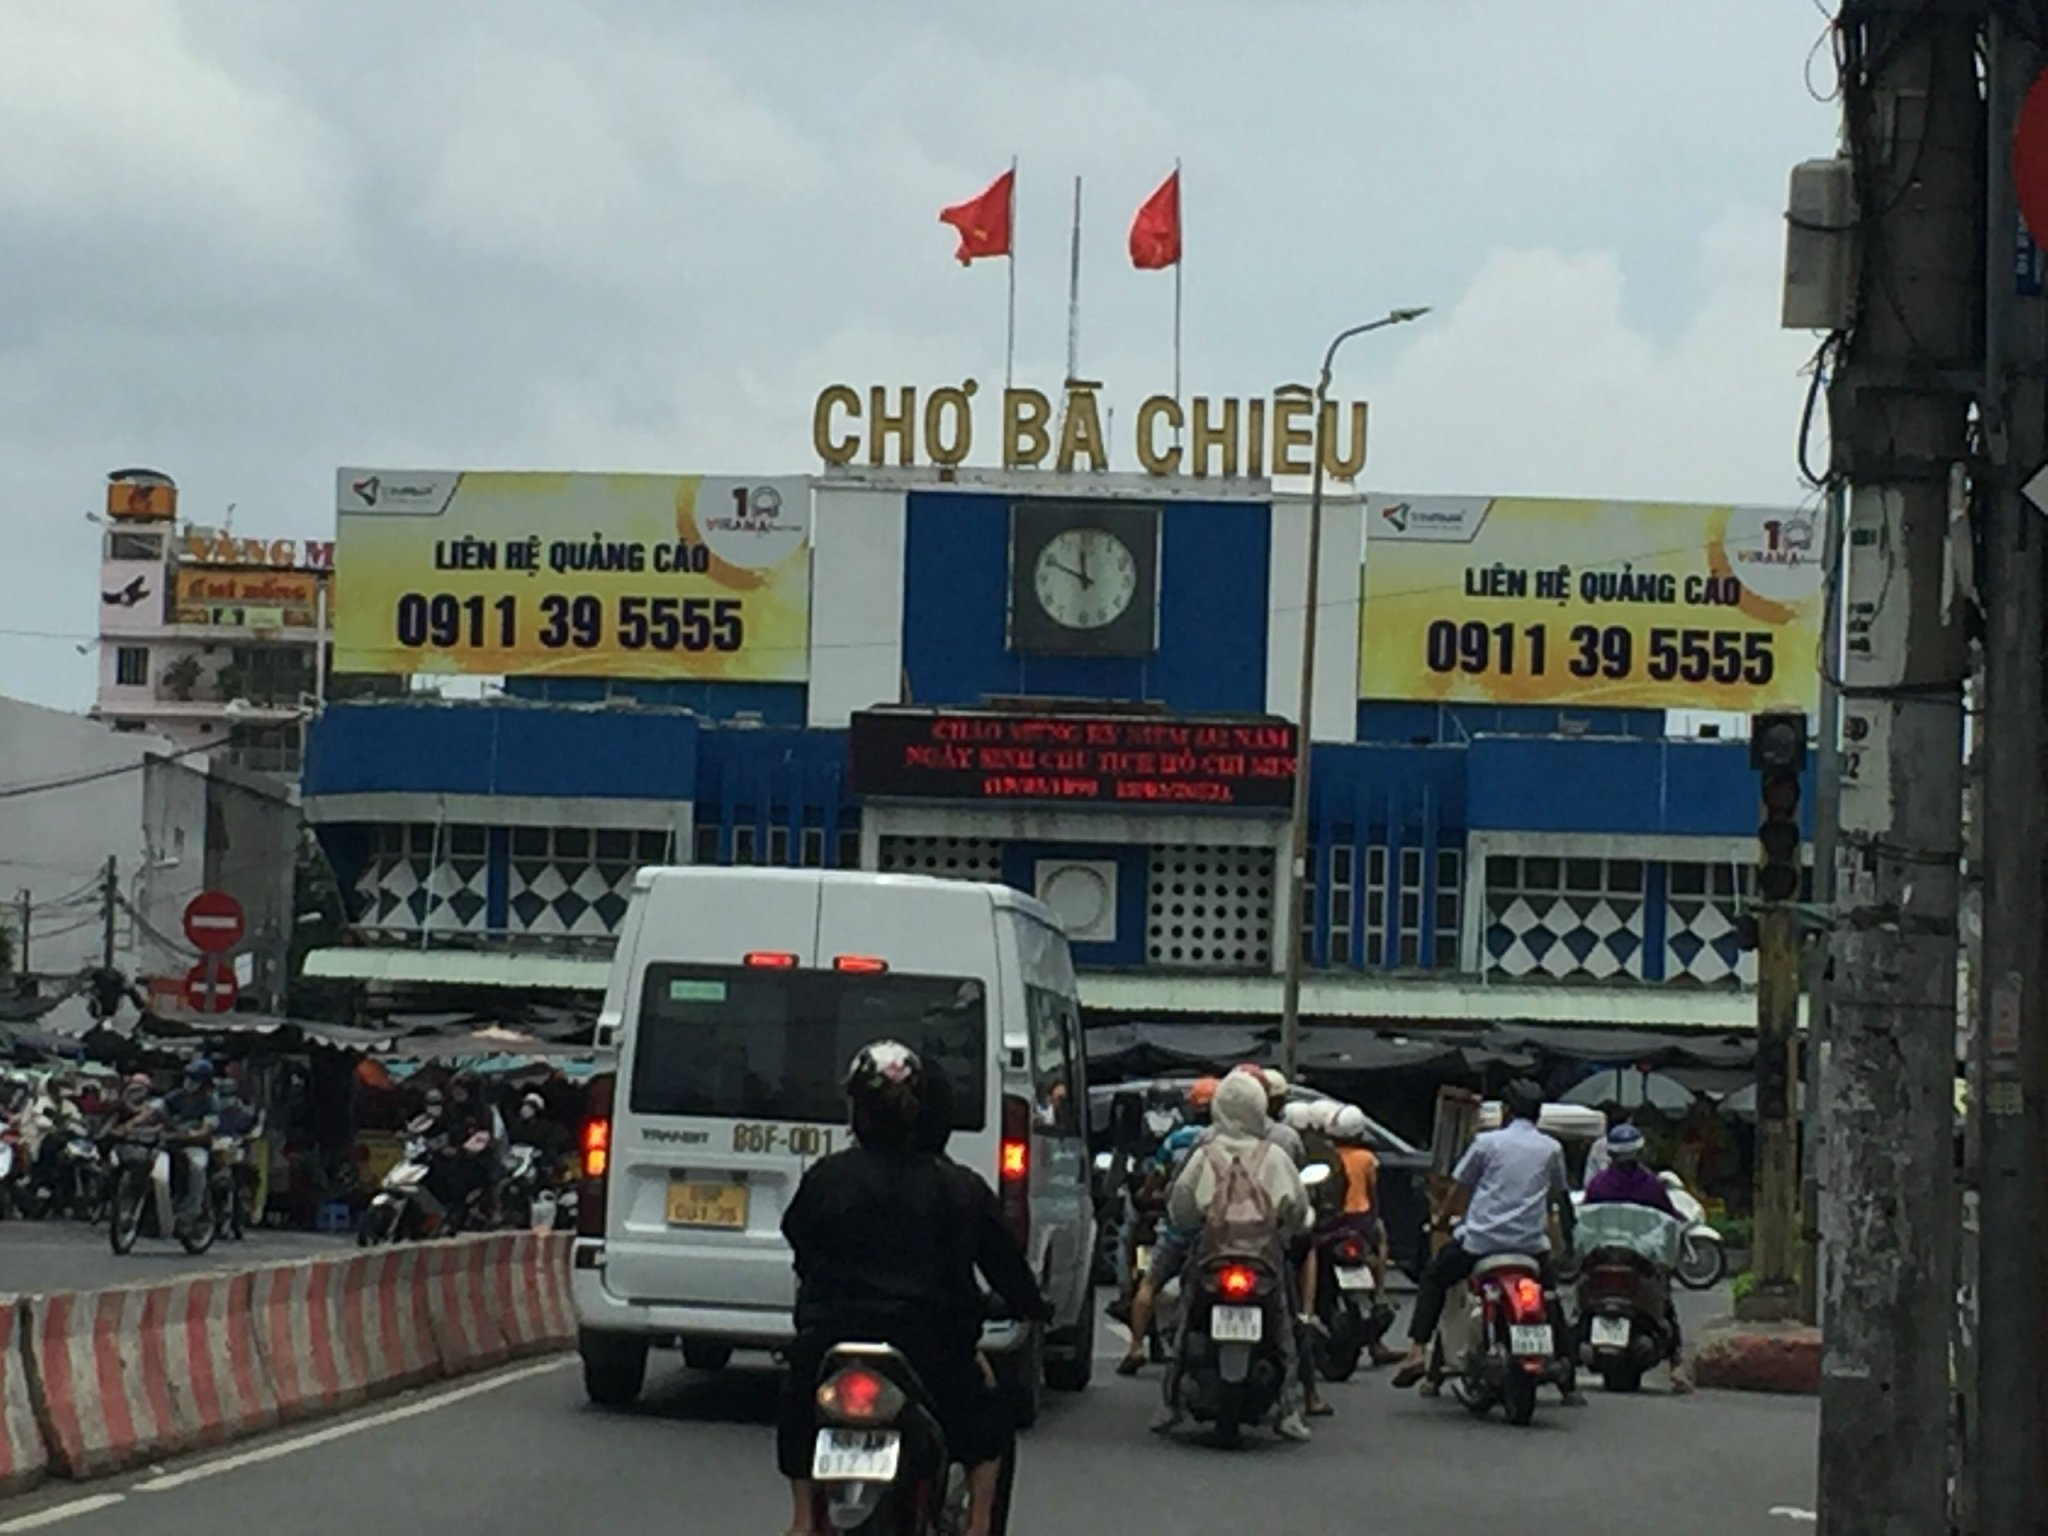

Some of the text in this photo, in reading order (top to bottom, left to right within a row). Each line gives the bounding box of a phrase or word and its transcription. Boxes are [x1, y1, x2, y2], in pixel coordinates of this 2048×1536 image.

[814, 378, 978, 482] CHỢ
[436, 531, 709, 577] LIÊN HỆ QUẢNG CÁO
[1465, 562, 1741, 607] LIÊN HỆ QUẢNG CÁO
[397, 594, 743, 651] 0911 39 5555
[1427, 620, 1773, 685] 0911 39 5555
